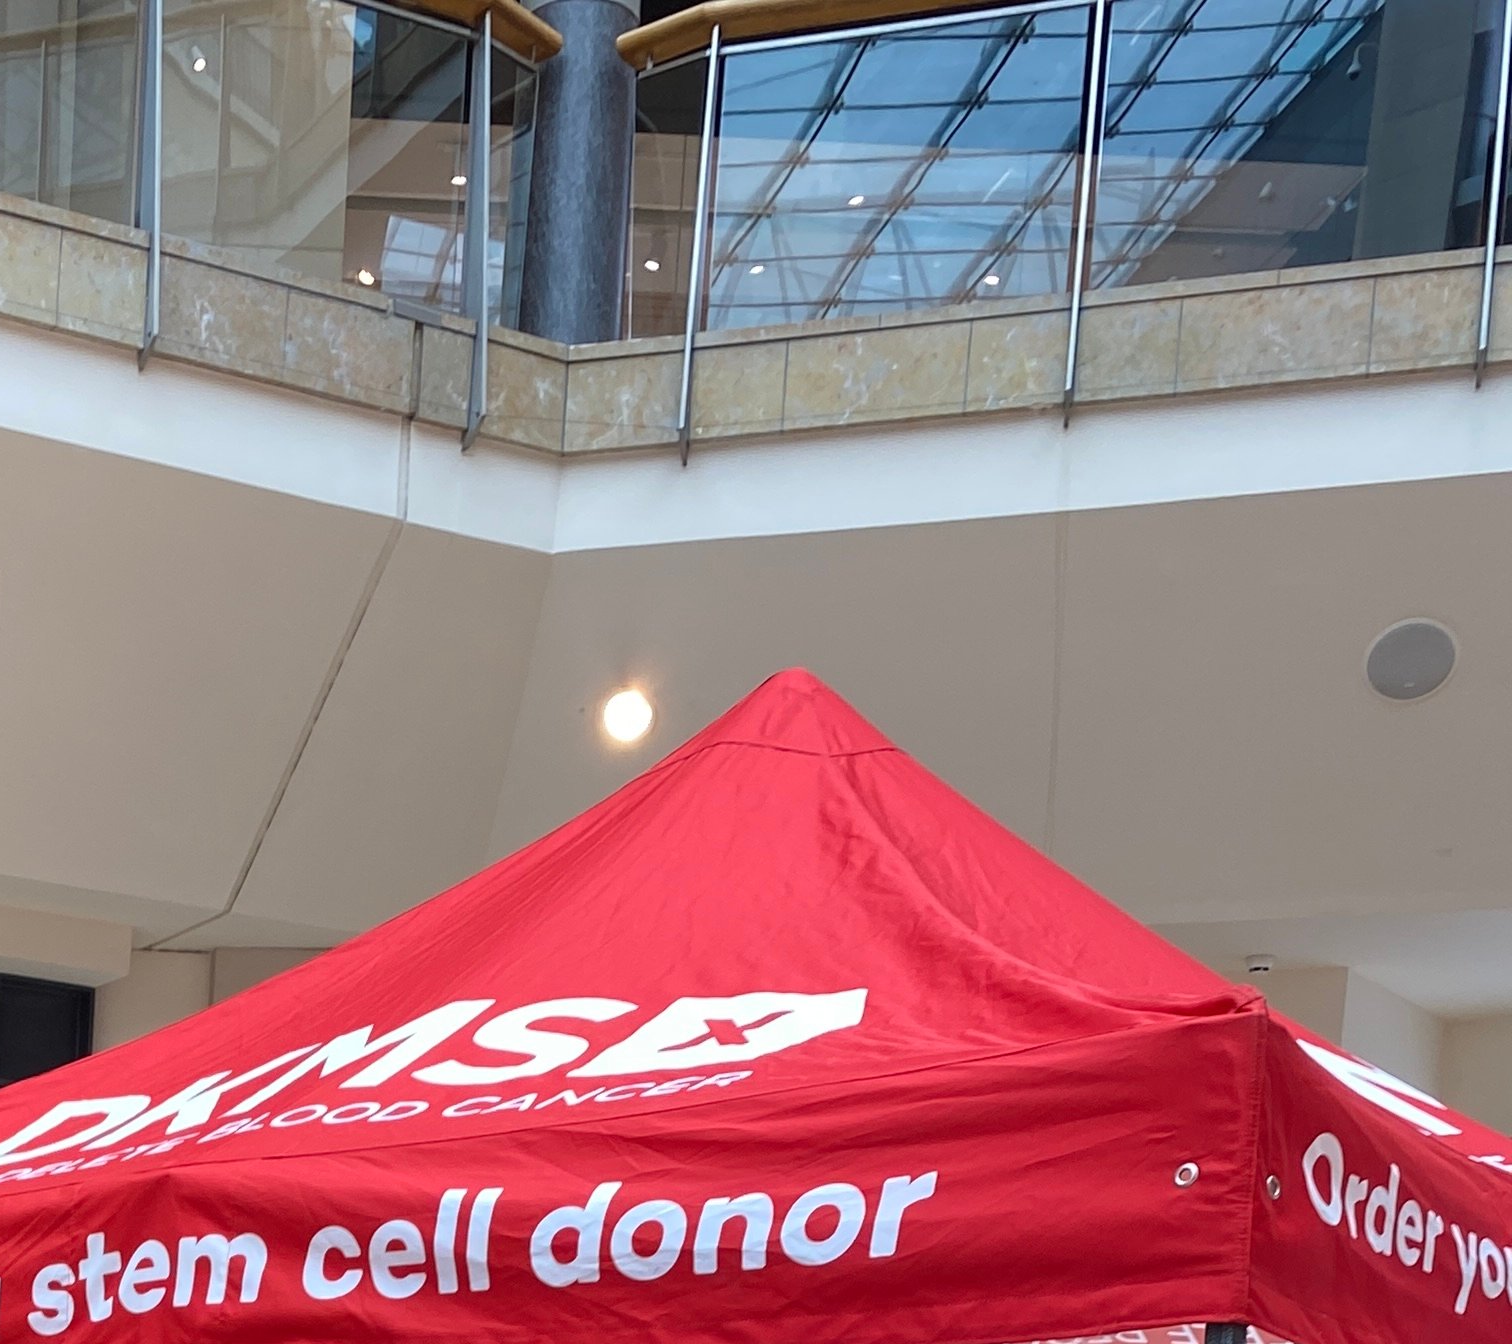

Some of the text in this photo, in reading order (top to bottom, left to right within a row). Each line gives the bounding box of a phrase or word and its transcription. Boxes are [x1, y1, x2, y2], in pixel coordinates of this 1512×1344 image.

[197, 1100, 430, 1145] BLOOD
[441, 1070, 753, 1119] CANCER
[27, 1232, 269, 1337] stem
[302, 1187, 503, 1300] cell
[529, 1171, 939, 1289] donor
[1302, 1132, 1444, 1274] Order
